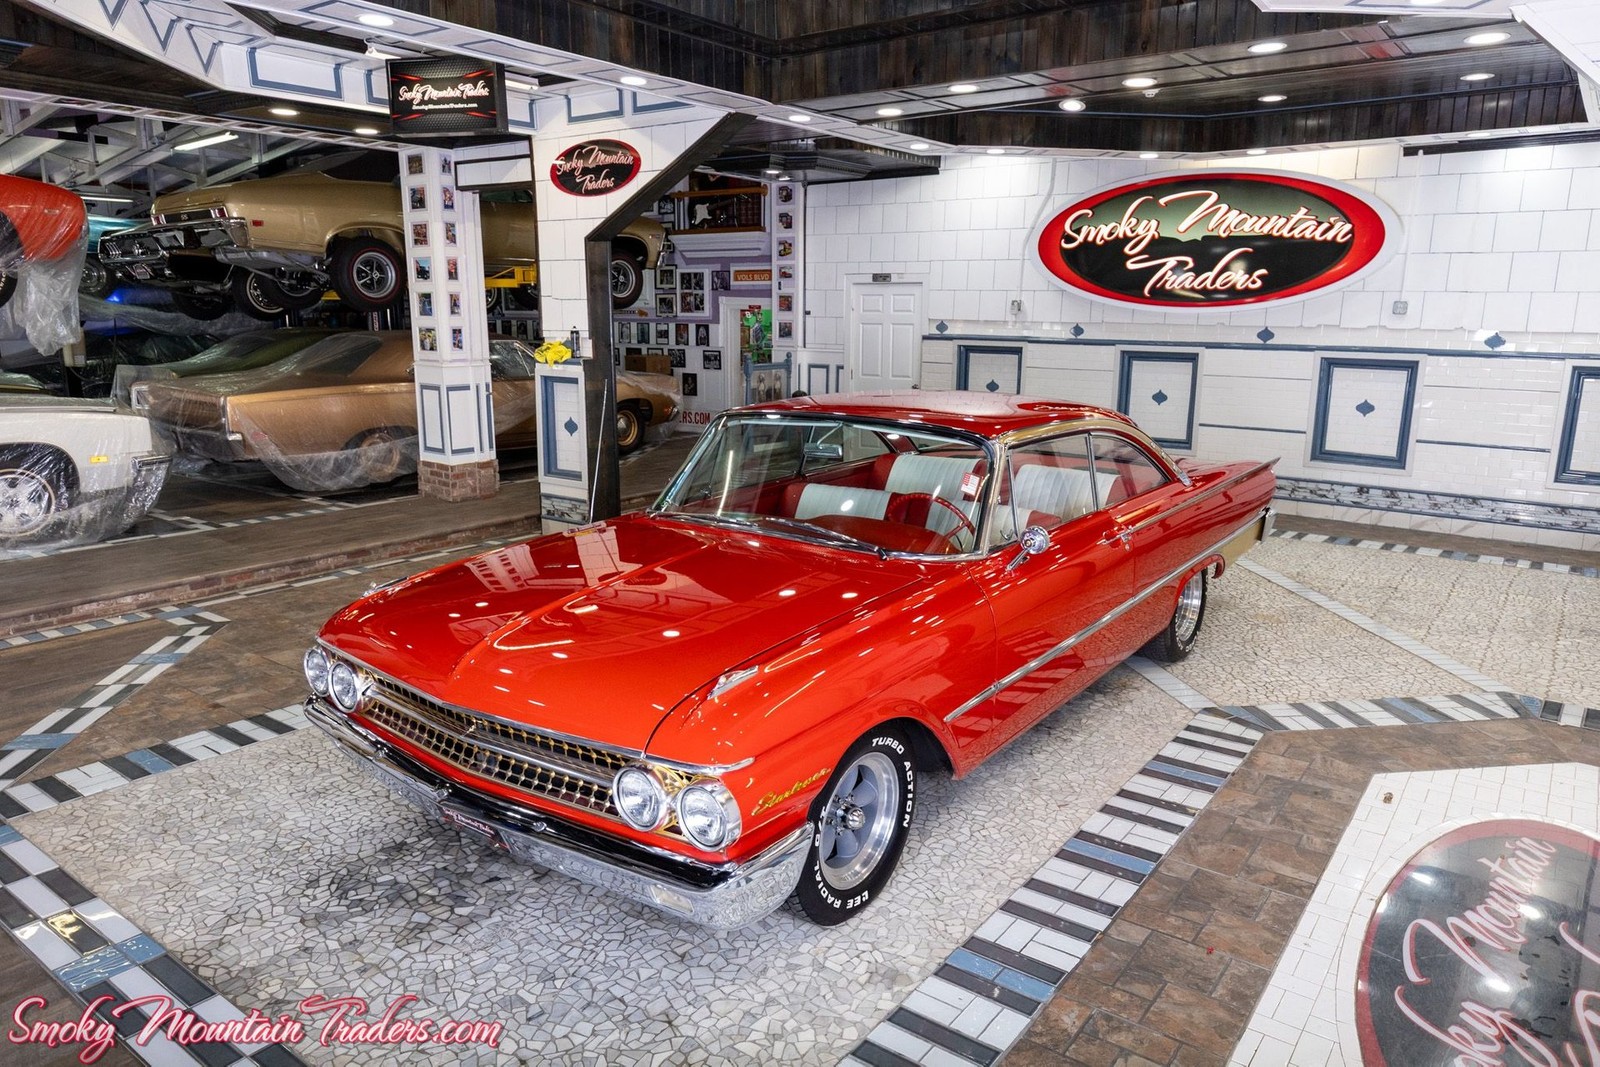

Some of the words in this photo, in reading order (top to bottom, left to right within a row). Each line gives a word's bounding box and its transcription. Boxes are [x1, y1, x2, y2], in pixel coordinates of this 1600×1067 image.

[556, 149, 584, 175] Smoky
[582, 145, 634, 166] Mountain
[576, 169, 615, 194] Traders
[1061, 195, 1160, 255] Smoky
[1158, 190, 1354, 244] Mountain
[1125, 247, 1269, 298] Traders
[680, 411, 711, 425] RS.COM
[872, 737, 905, 755] TURBO
[903, 761, 914, 828] ACTION
[814, 860, 842, 909] RADIAL
[1402, 837, 1557, 986] Mountain
